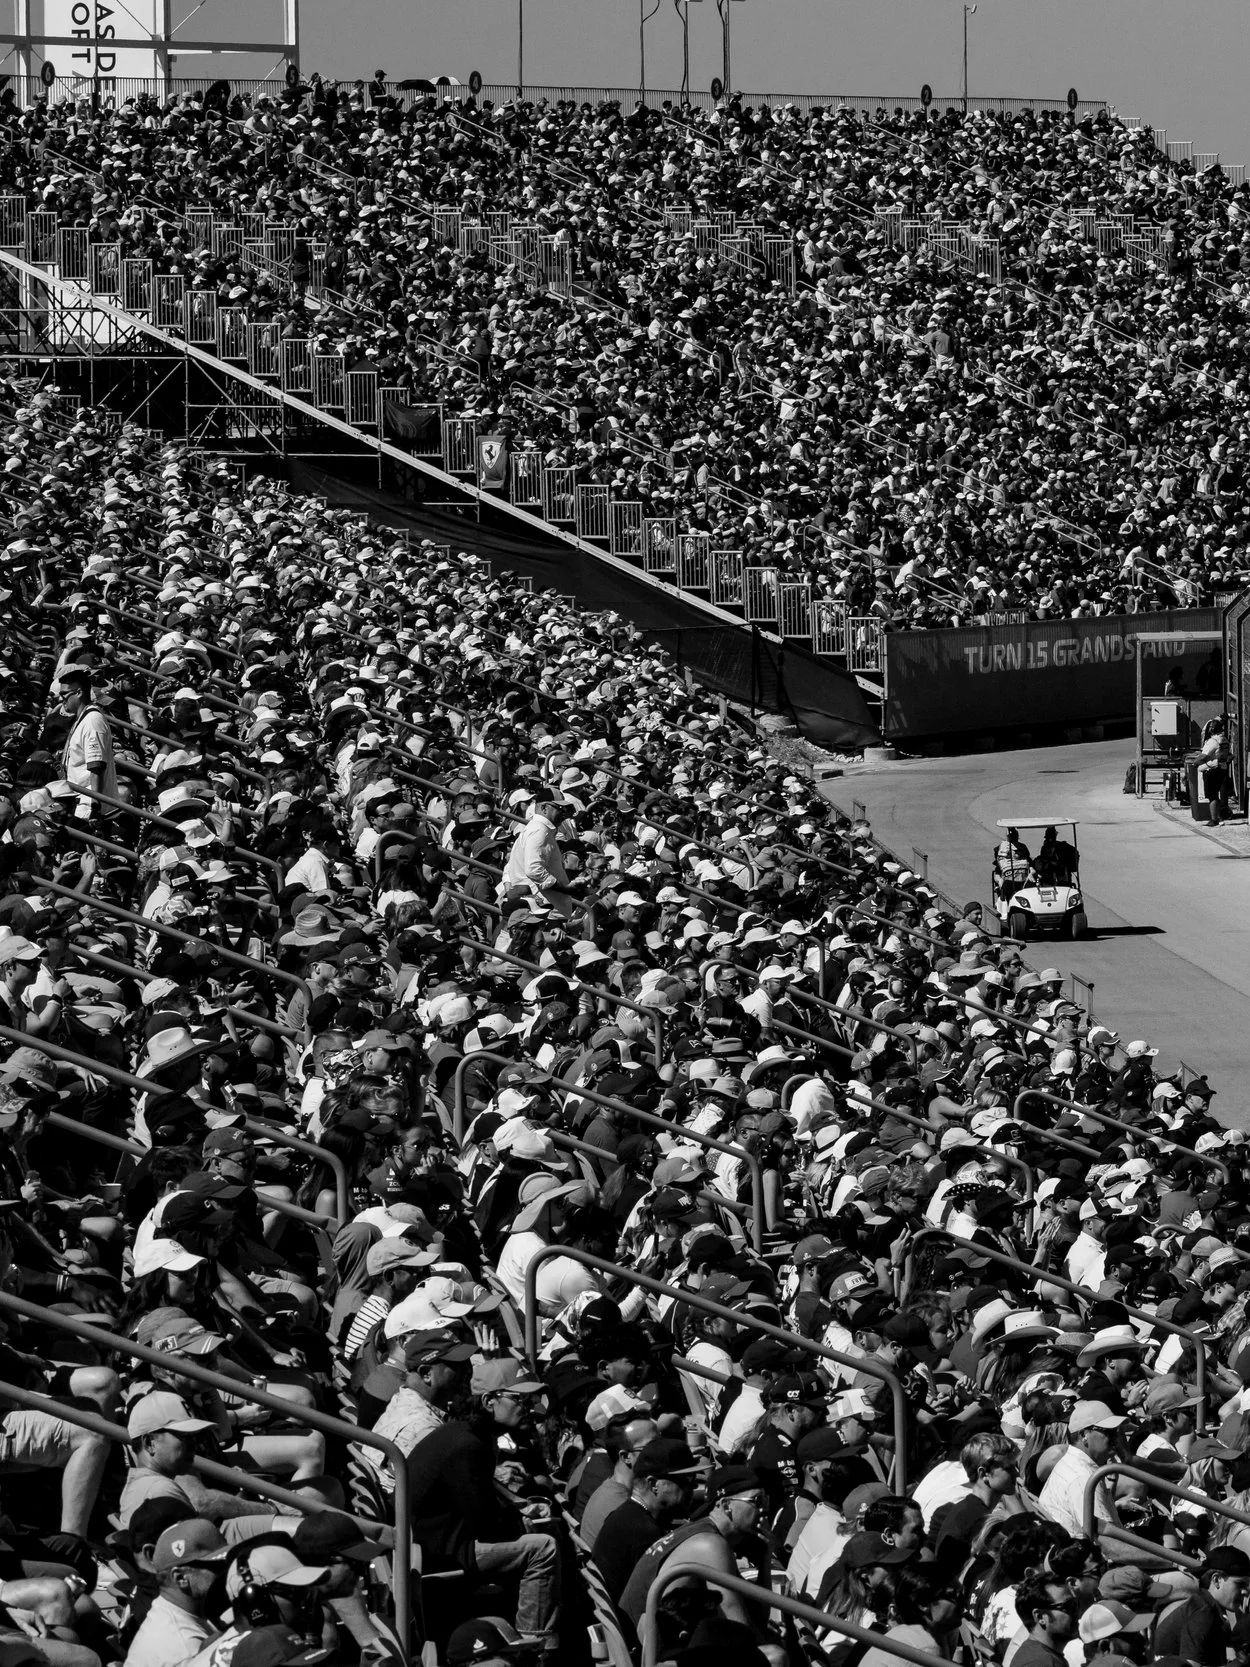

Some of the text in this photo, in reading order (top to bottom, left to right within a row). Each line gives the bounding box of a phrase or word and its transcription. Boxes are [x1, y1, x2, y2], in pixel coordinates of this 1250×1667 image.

[45, 66, 51, 82] 6
[289, 69, 295, 84] 5
[472, 75, 479, 90] 4
[713, 82, 720, 96] 3
[923, 88, 930, 102] 2
[963, 634, 1186, 675] TURN 15 GRANDSAND
